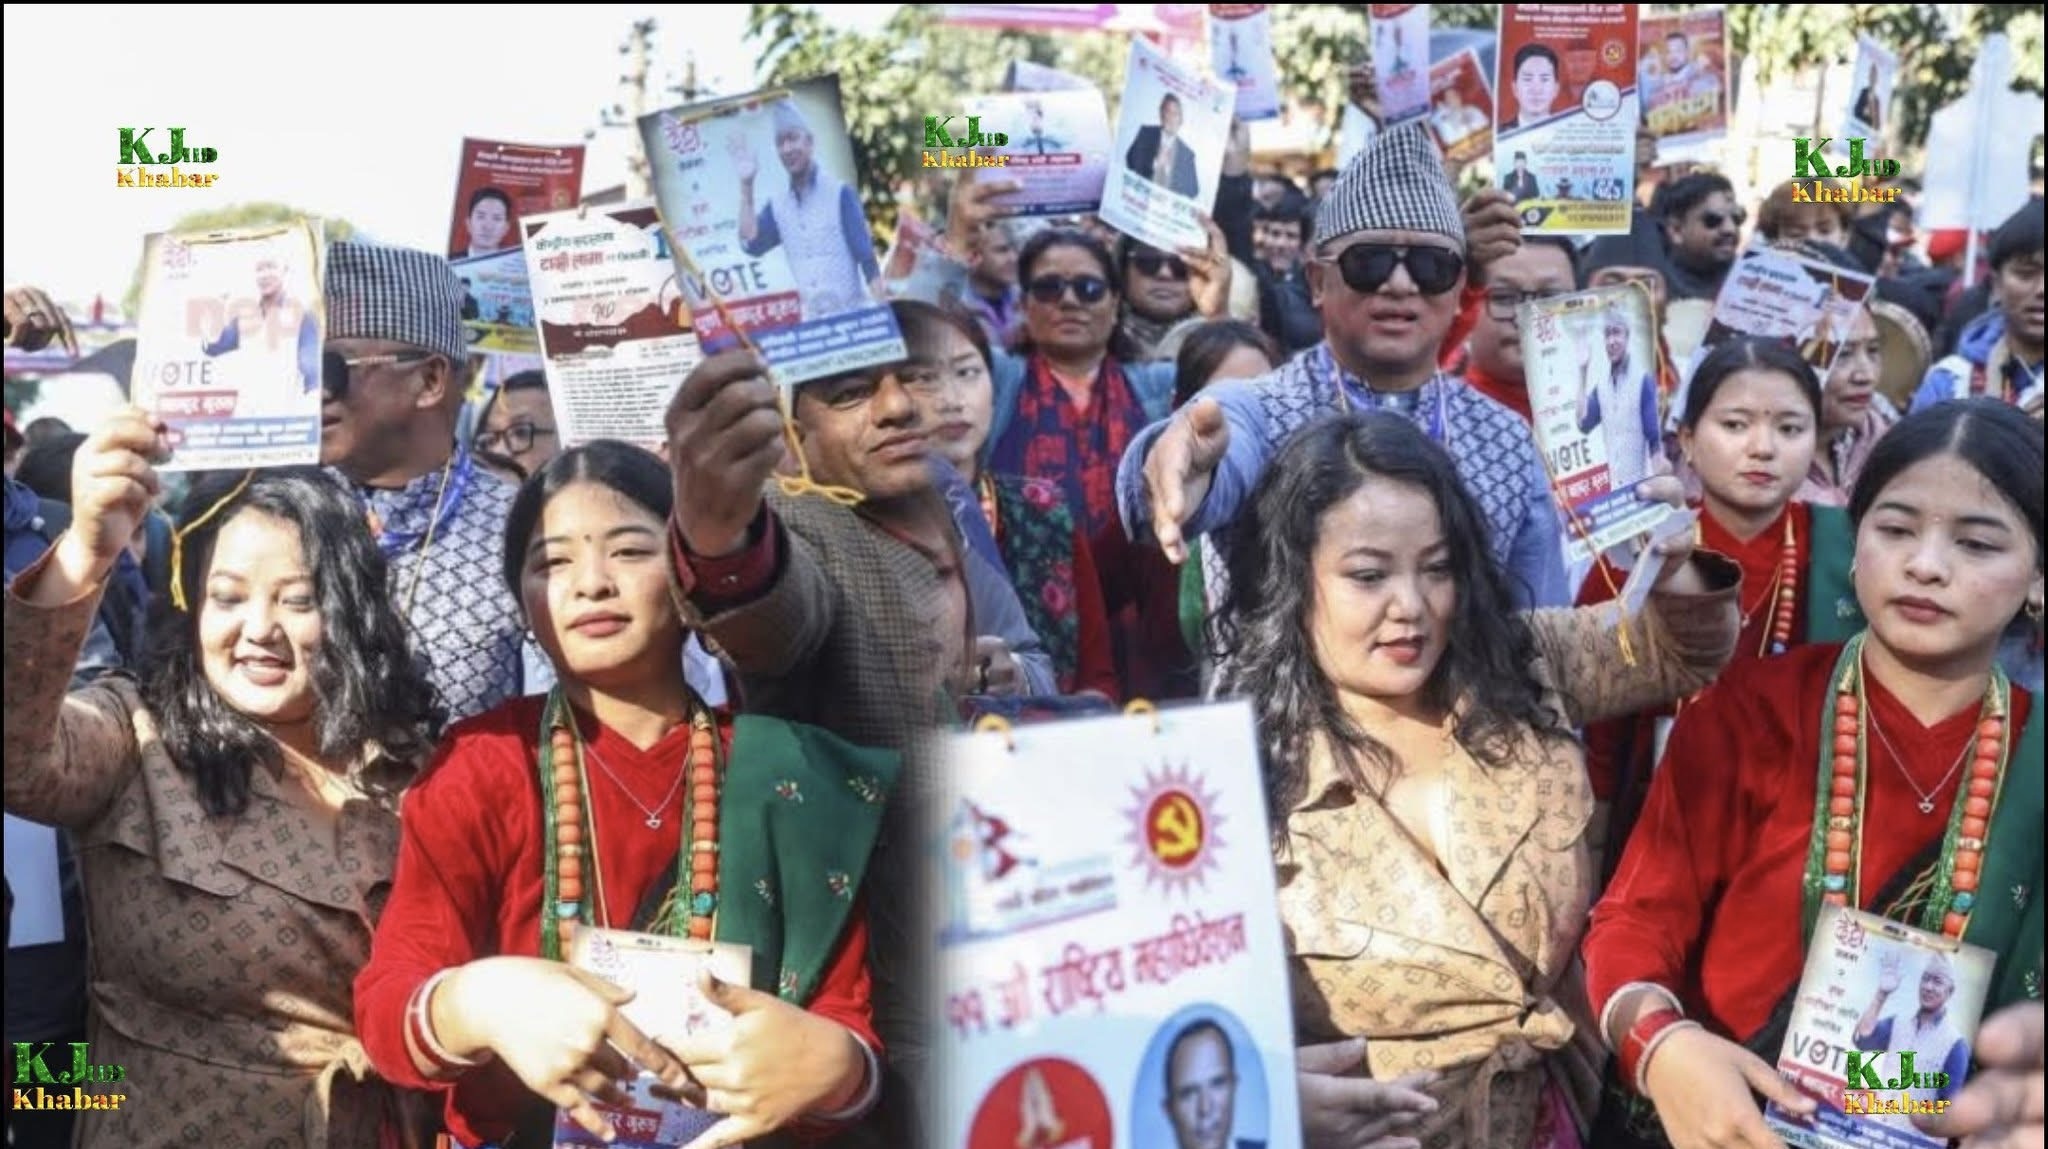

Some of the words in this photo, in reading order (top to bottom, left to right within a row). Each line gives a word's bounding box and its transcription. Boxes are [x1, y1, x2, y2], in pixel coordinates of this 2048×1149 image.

[686, 260, 768, 300] VOTE
[1545, 438, 1592, 475] VOTE
[1793, 1033, 1849, 1075] VOT
